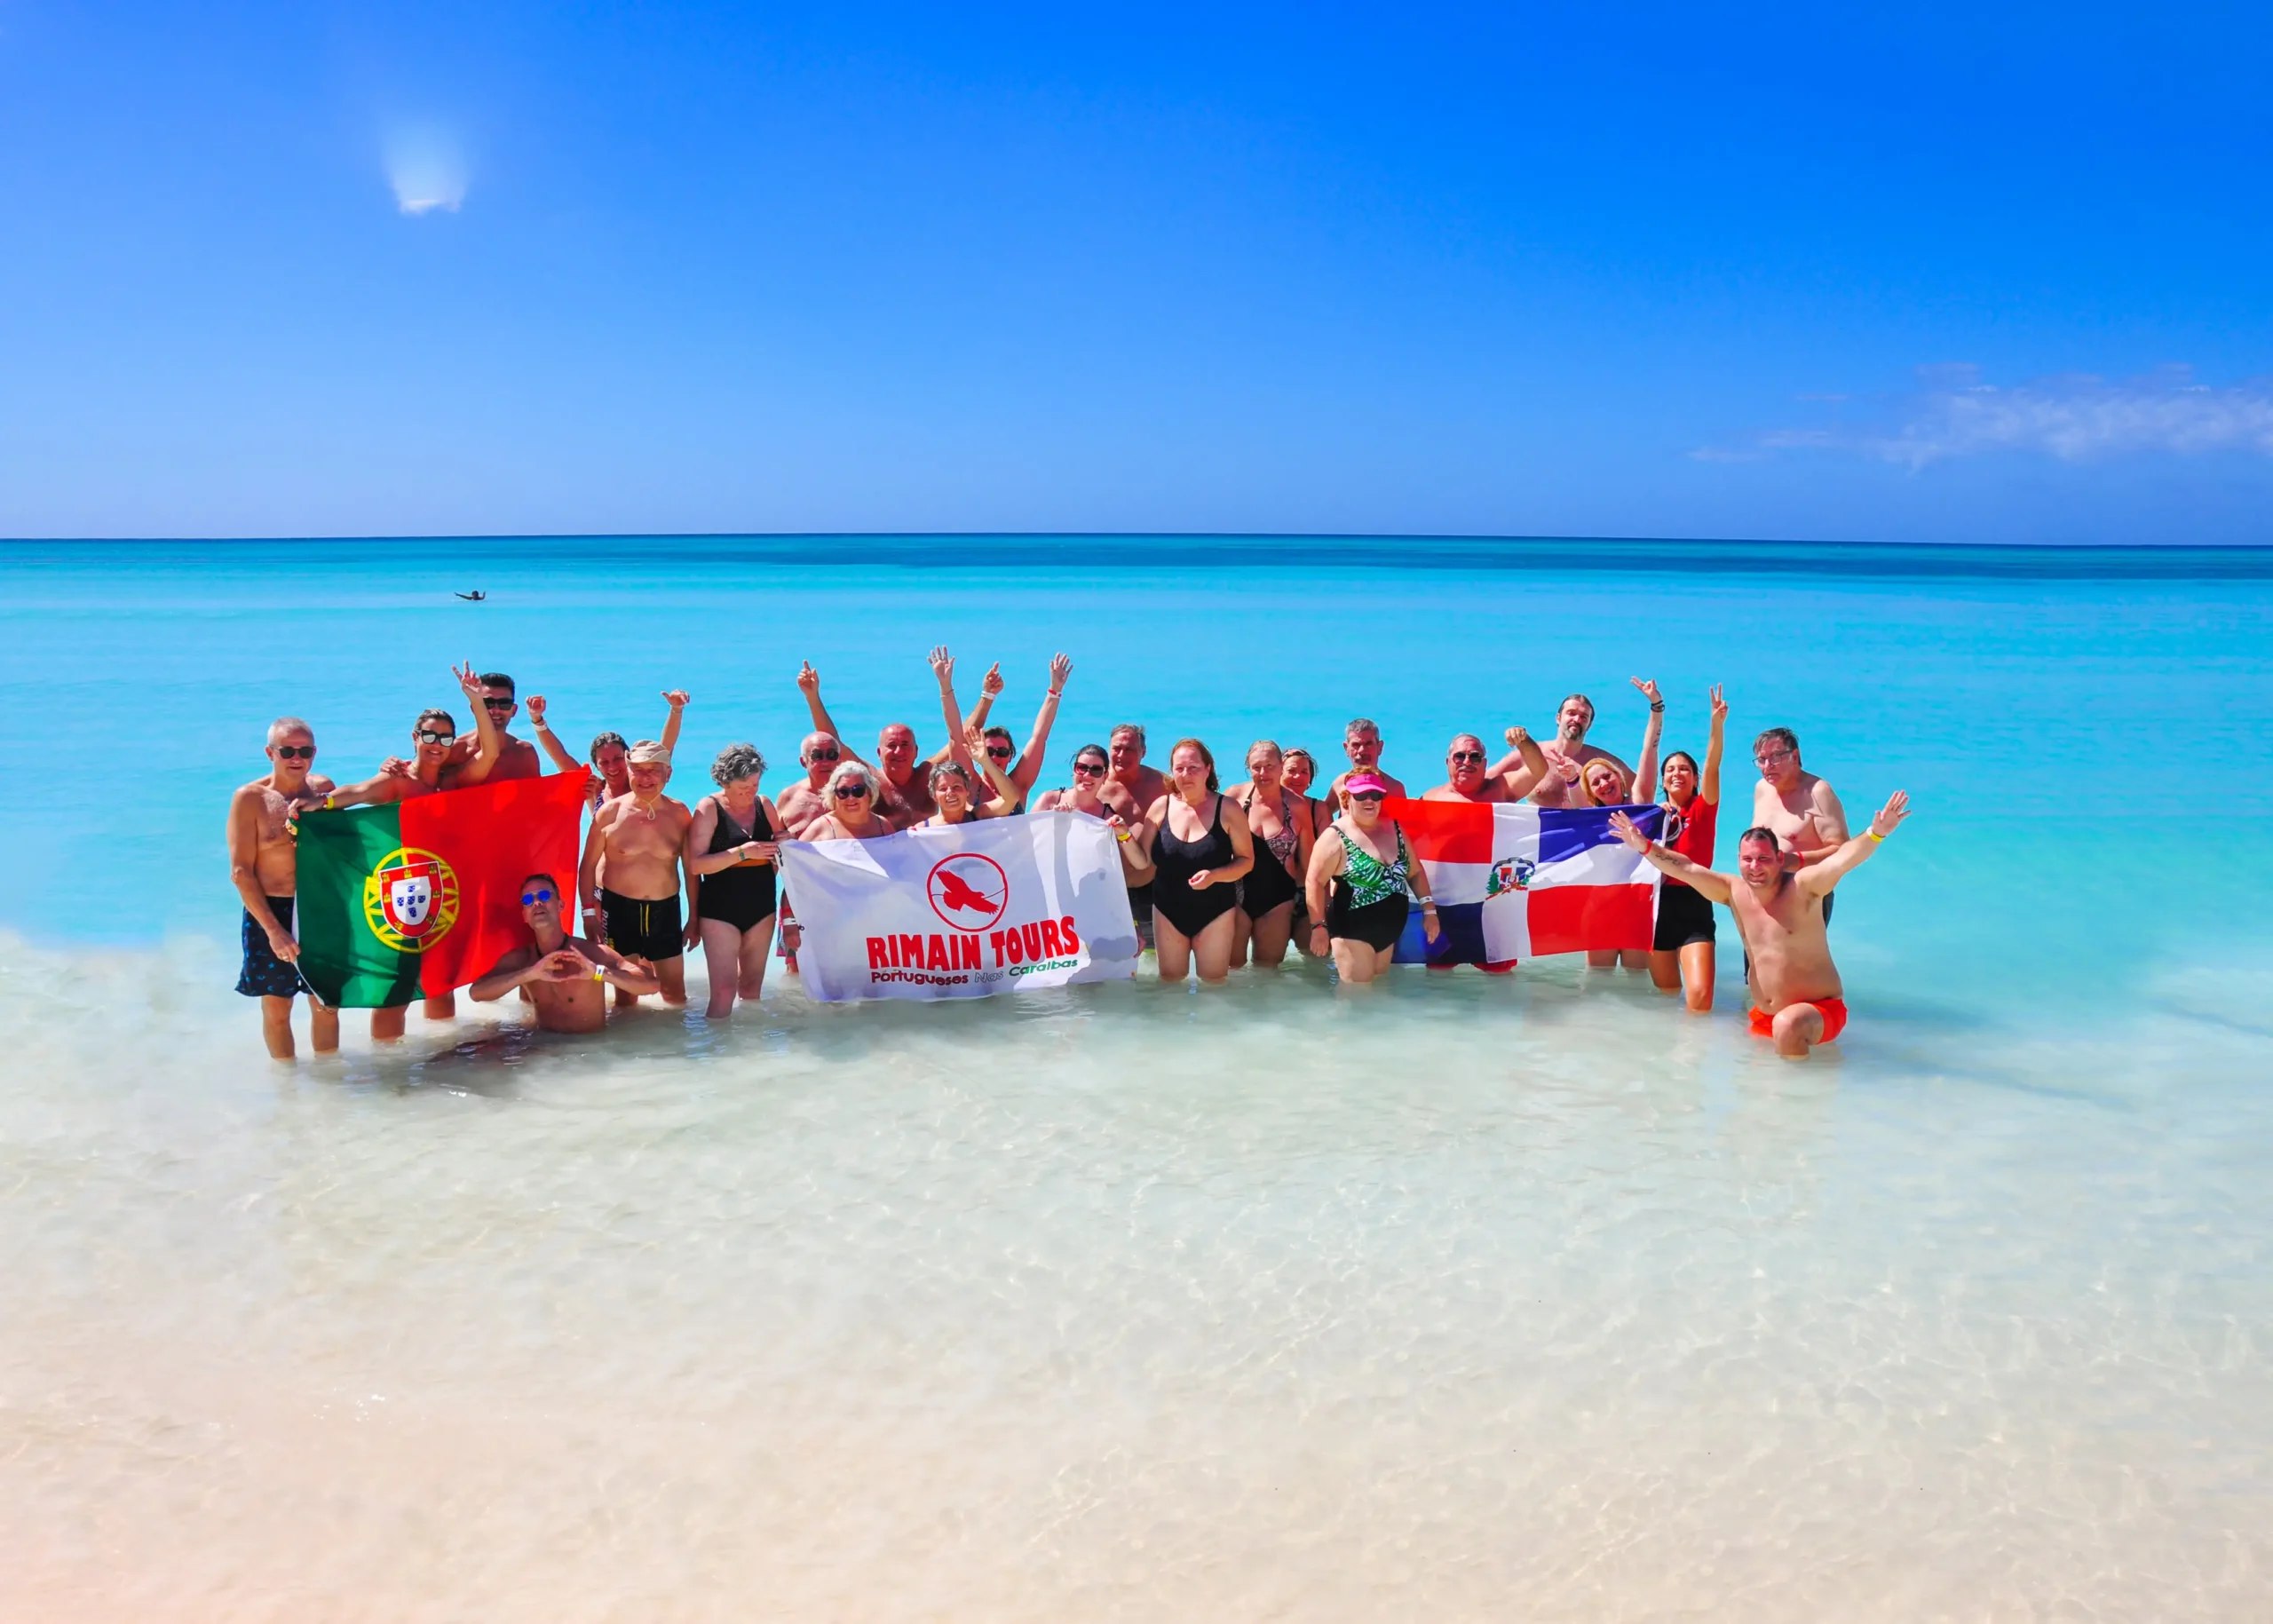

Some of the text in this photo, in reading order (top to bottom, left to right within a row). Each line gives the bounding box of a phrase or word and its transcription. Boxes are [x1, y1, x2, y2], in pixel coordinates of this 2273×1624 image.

[866, 915, 1080, 971] RIMAIN TOURS
[871, 970, 969, 986] Portugueses
[975, 971, 1004, 984] Nas
